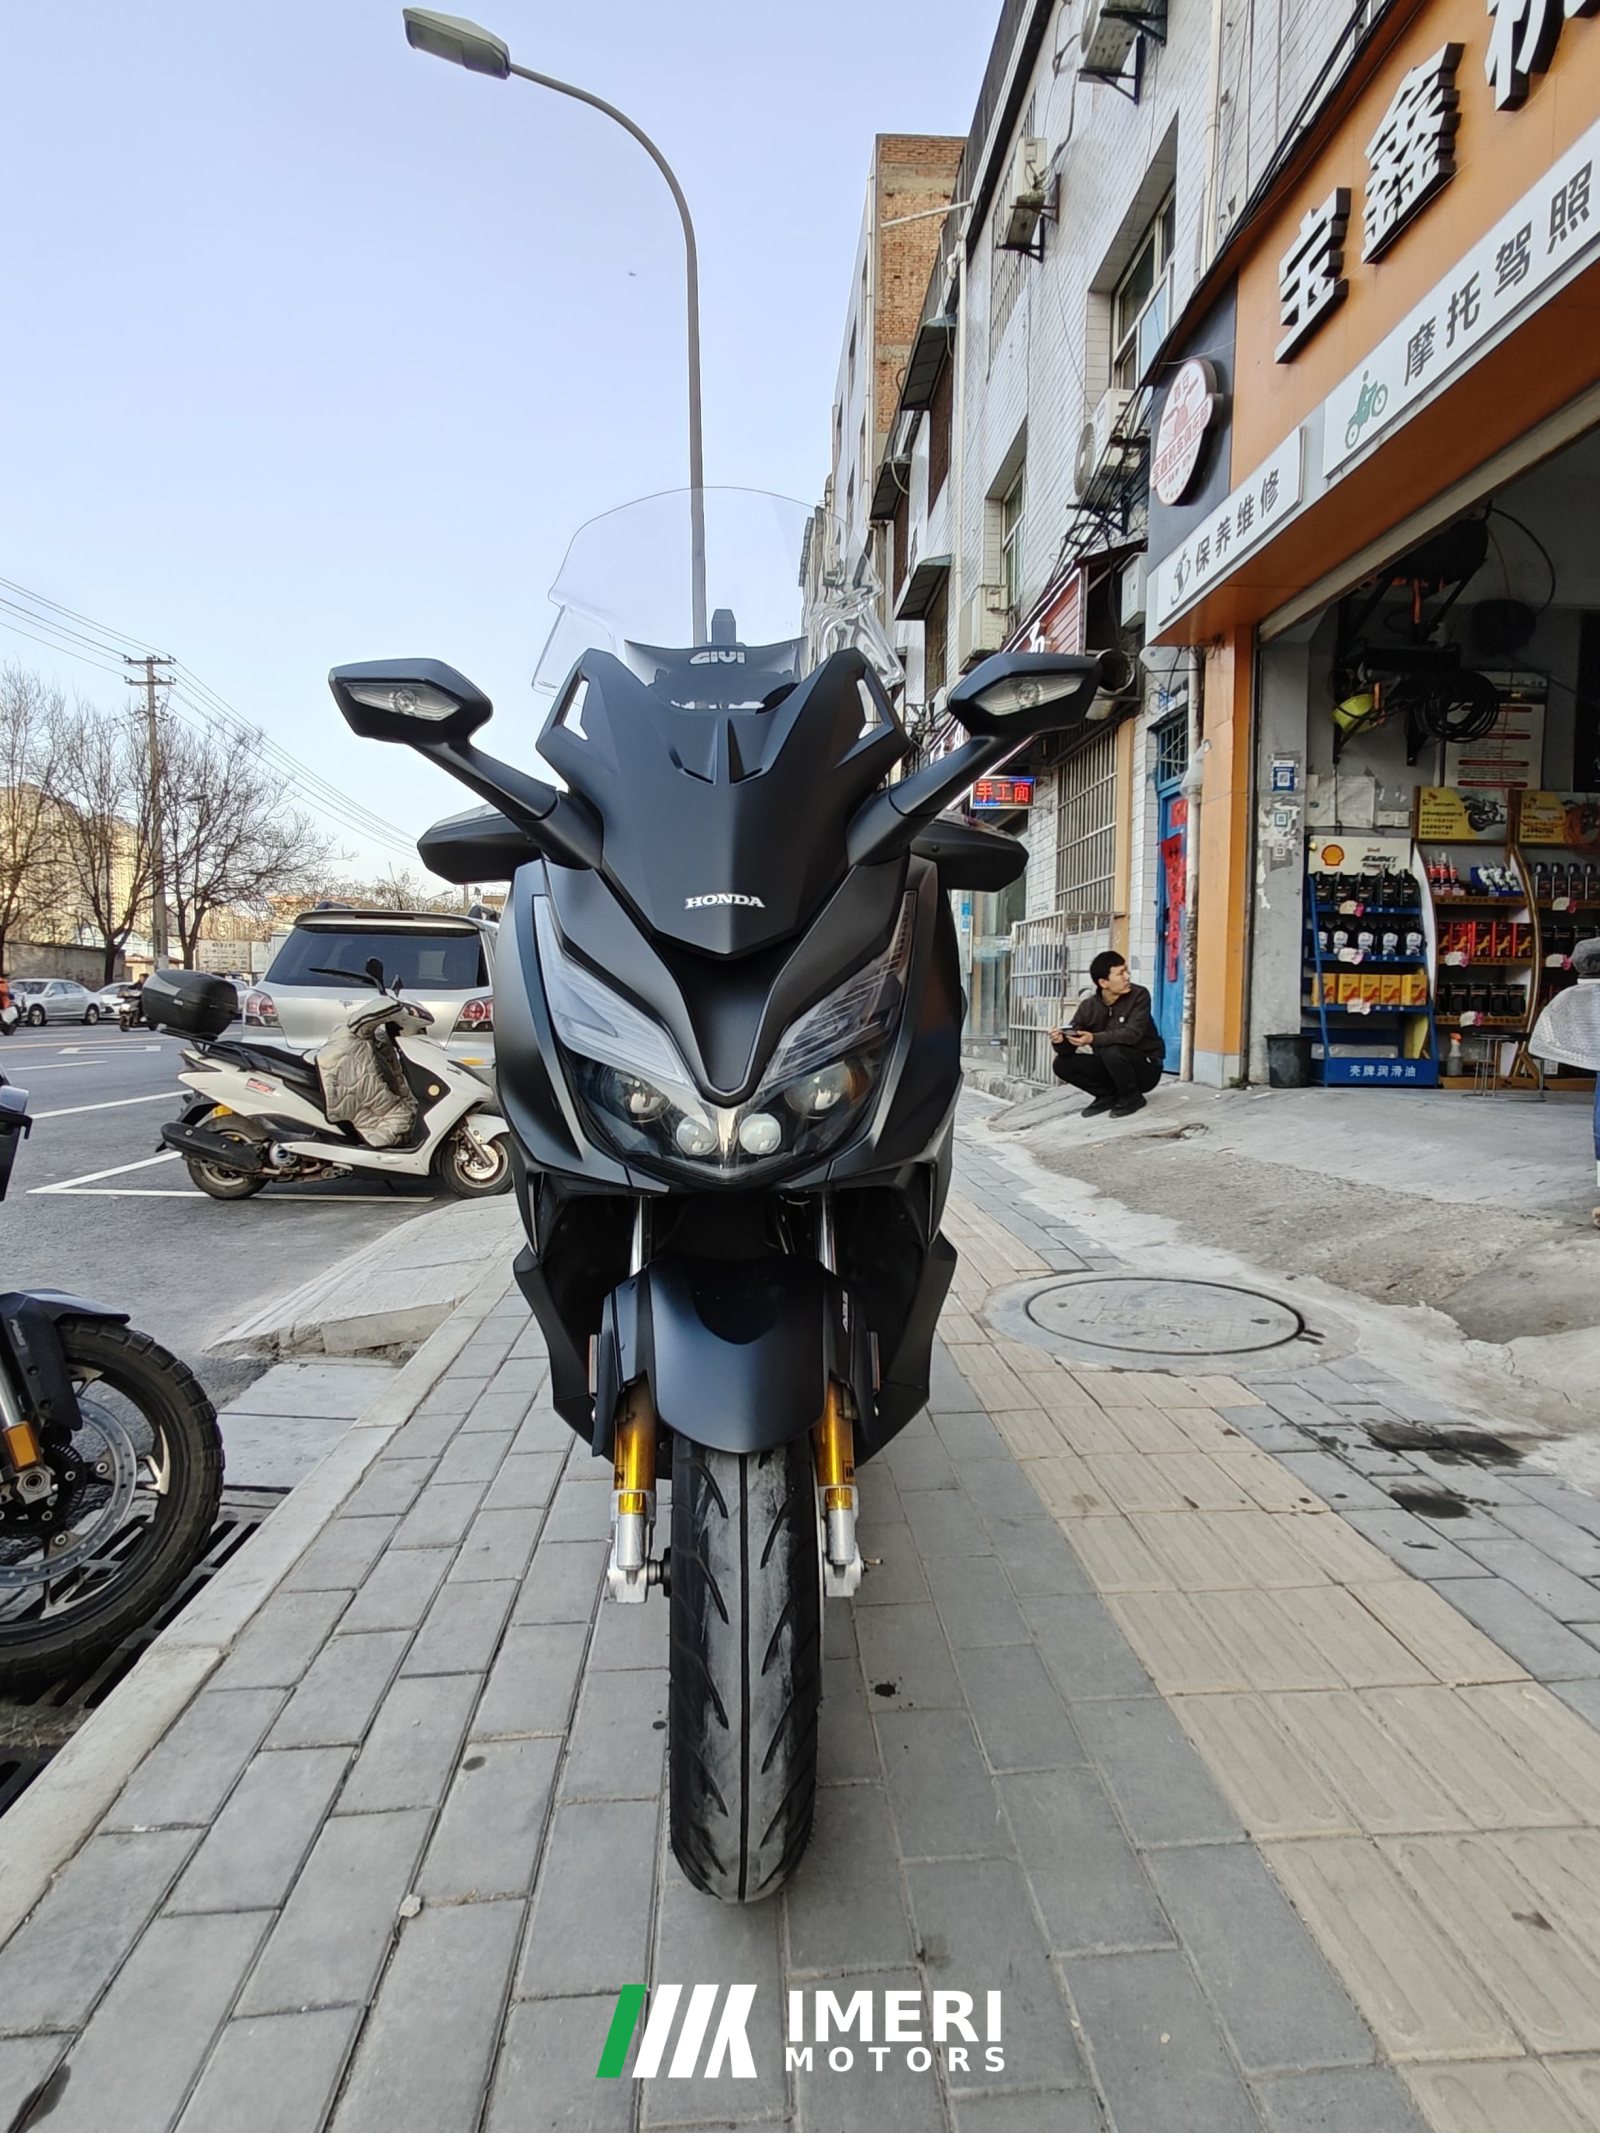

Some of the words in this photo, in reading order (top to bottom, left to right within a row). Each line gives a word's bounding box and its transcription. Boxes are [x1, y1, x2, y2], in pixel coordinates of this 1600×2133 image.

[1404, 160, 1593, 387] 摩托驾照
[1196, 468, 1280, 577] 保养维修
[689, 651, 745, 665] GIVI
[976, 782, 1032, 803] 手工面
[685, 893, 766, 909] HONDA
[1349, 1065, 1417, 1078] 壳牌润滑油
